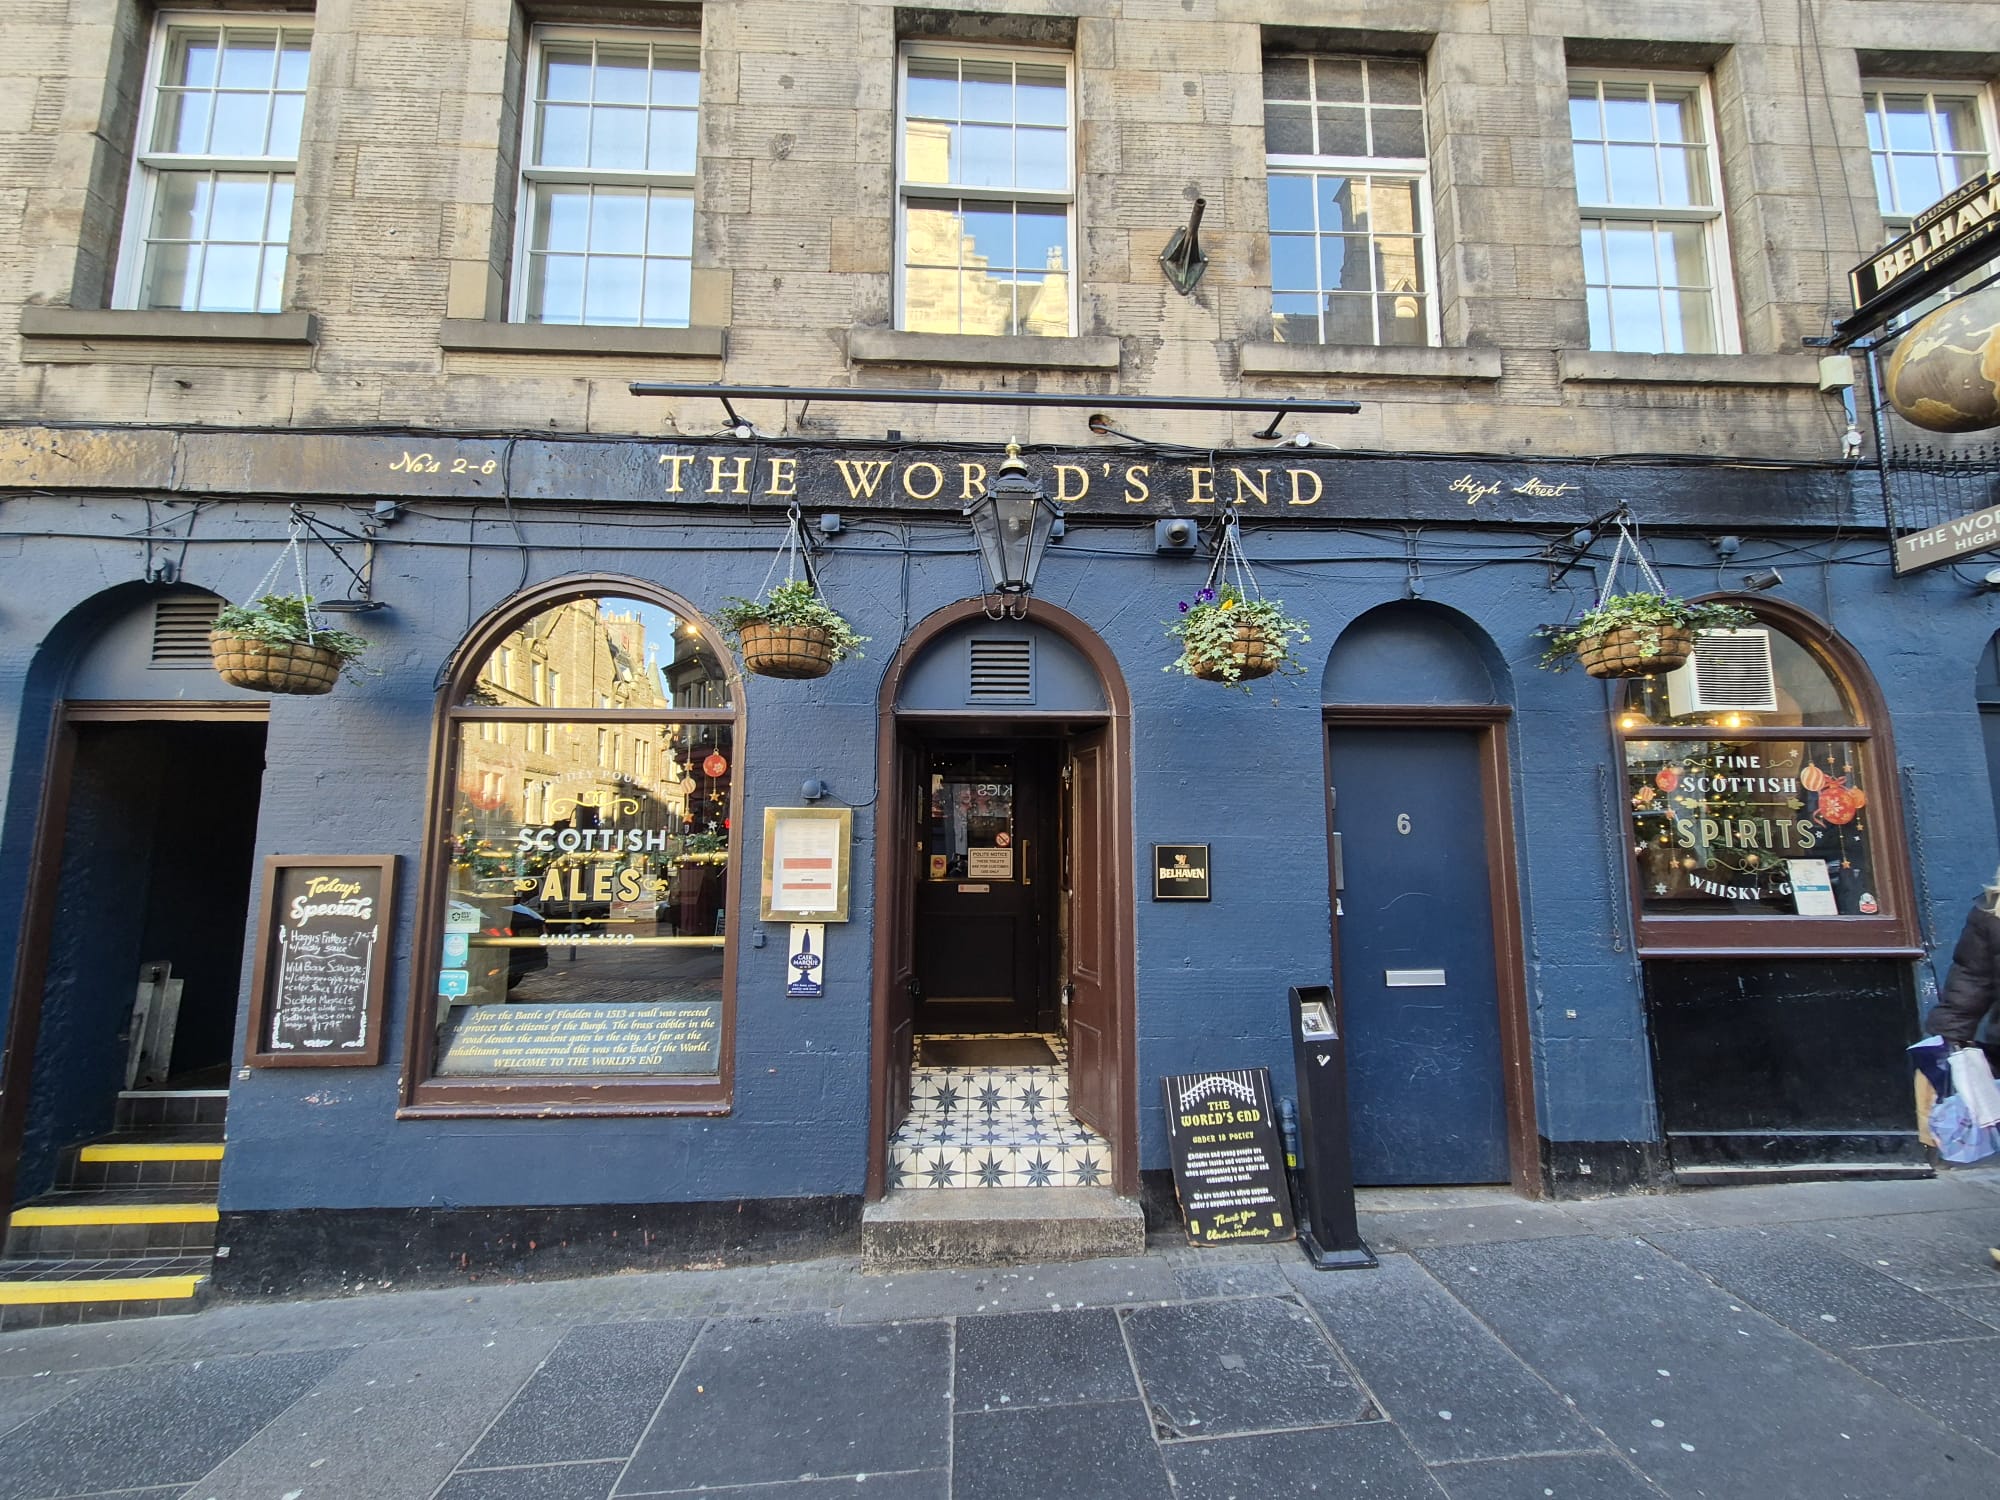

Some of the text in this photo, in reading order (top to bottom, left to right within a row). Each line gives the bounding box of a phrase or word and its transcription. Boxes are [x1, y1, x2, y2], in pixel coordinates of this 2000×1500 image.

[1918, 180, 1980, 226] DUNBAR
[450, 458, 497, 474] 2-8
[658, 454, 1324, 505] THE WORD'S END
[1449, 474, 1581, 504] High Street
[1905, 528, 1948, 552] THE
[1955, 529, 1998, 551] HIGH
[1715, 755, 1761, 769] FINE
[1682, 776, 1798, 793] SCOTTISH
[1396, 813, 1412, 835] 6
[517, 828, 667, 852] SCOTTISH
[1677, 818, 1816, 849] SPIRITS
[1159, 867, 1205, 880] BELHAVEN
[305, 876, 361, 900] Today's
[540, 867, 641, 902] ALES
[1689, 873, 1762, 900] WHISKY
[289, 896, 373, 928] Specials
[291, 930, 321, 946] Haggis
[539, 933, 635, 946] SINCE 1719
[472, 1010, 496, 1024] After
[498, 1010, 513, 1020] the
[515, 1011, 542, 1020] Battle
[544, 1010, 555, 1023] of
[556, 1009, 591, 1019] Flodden
[594, 1009, 604, 1018] in
[606, 1009, 626, 1018] 1513
[638, 1008, 657, 1017] wall
[678, 1007, 711, 1017] erected
[463, 1023, 498, 1034] protect
[499, 1022, 514, 1032] the
[516, 1022, 549, 1031] citizens
[551, 1021, 561, 1034] of
[563, 1020, 578, 1031] the
[612, 1020, 629, 1030] The
[630, 1020, 653, 1029] brass
[656, 1019, 686, 1029] cobbles
[688, 1018, 698, 1028] in
[700, 1018, 715, 1028] the
[486, 1033, 513, 1043] denote
[516, 1032, 532, 1043] the
[534, 1032, 566, 1042] ancient
[568, 1034, 591, 1049] gates
[594, 1033, 603, 1042] to
[606, 1032, 620, 1042] the
[643, 1032, 656, 1041] As
[655, 1030, 672, 1044] far
[674, 1032, 685, 1040] as
[687, 1030, 701, 1040] the
[448, 1046, 500, 1057] inhabitants
[502, 1047, 523, 1055] were
[525, 1044, 570, 1055] concerned
[573, 1043, 590, 1054] this
[593, 1046, 610, 1054] was
[613, 1043, 628, 1053] the
[630, 1043, 649, 1053] End
[650, 1042, 661, 1056] of
[663, 1042, 678, 1052] the
[493, 1055, 663, 1068] WELCOME TO THE WORLD'S END
[1207, 1100, 1231, 1111] THE
[1180, 1109, 1260, 1127] WORLD'S END
[1192, 1131, 1254, 1144] UNDER 18 POLICY
[1213, 1210, 1257, 1228] Thank You
[1206, 1227, 1271, 1240] Understanding
